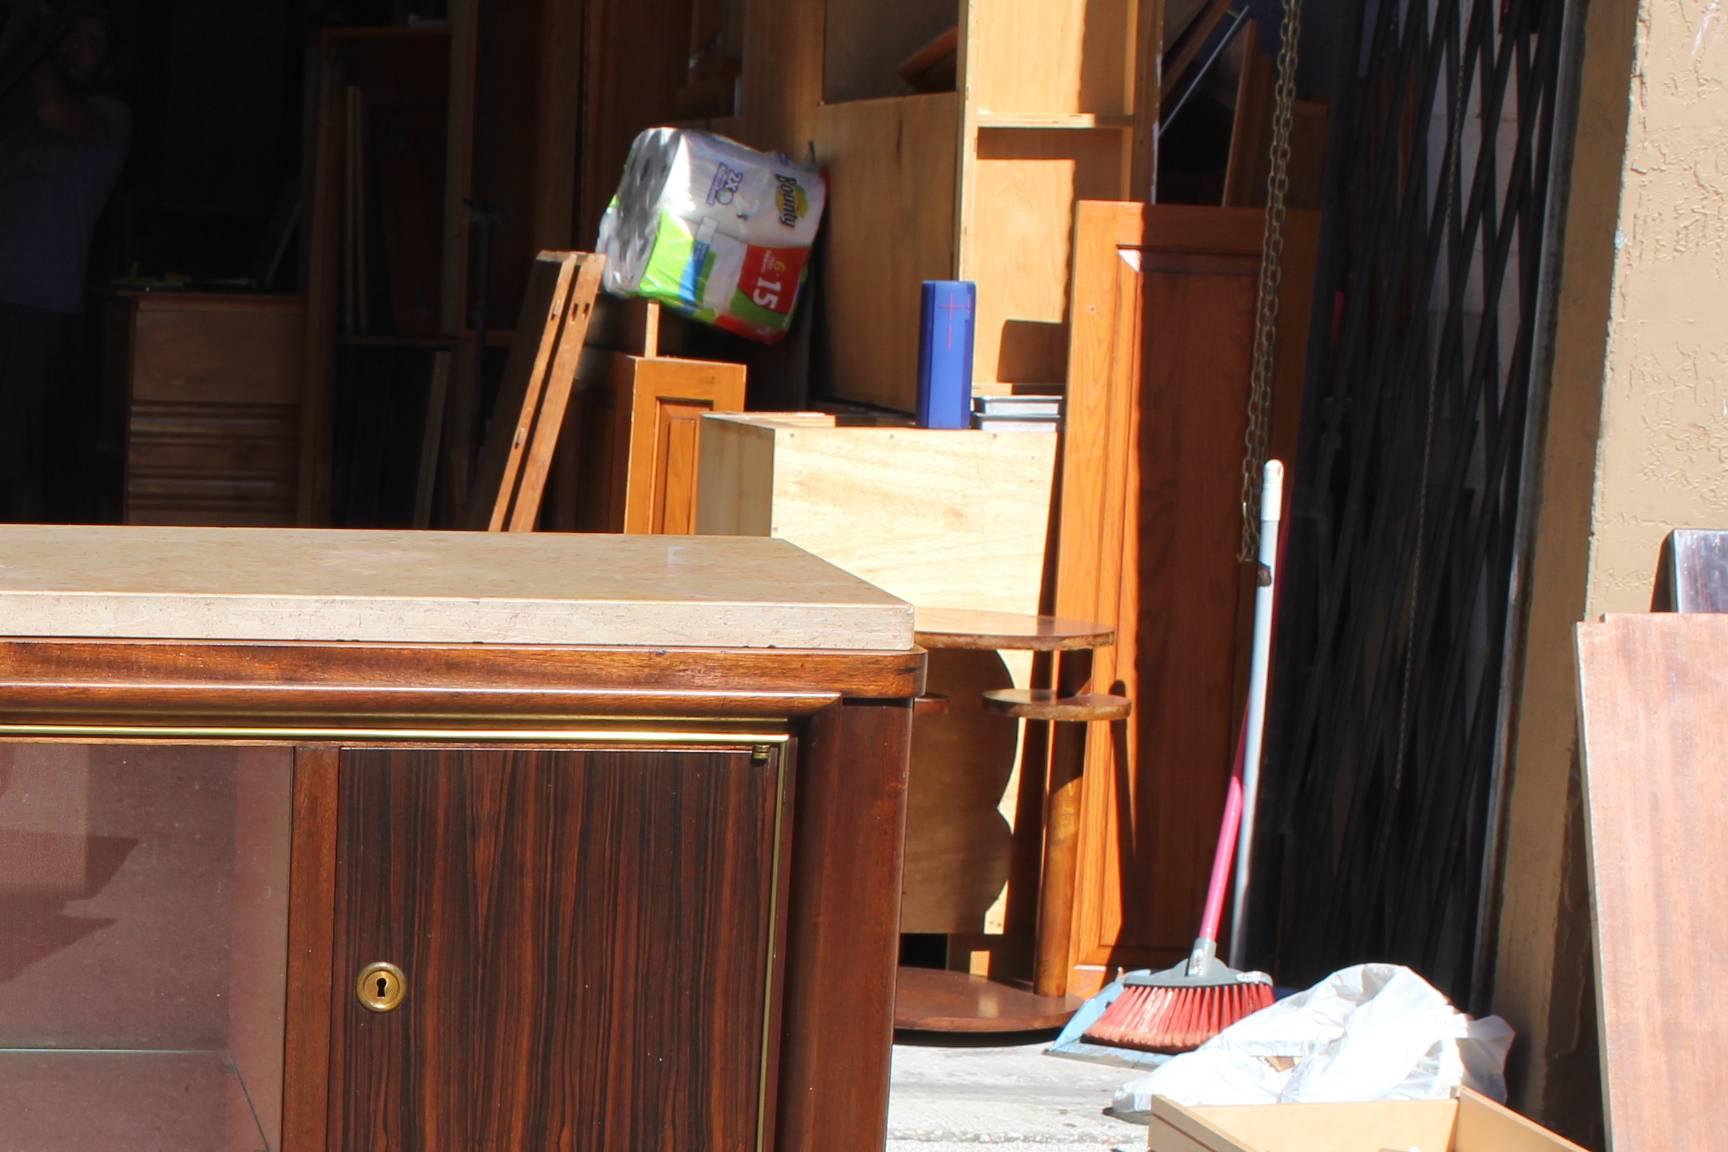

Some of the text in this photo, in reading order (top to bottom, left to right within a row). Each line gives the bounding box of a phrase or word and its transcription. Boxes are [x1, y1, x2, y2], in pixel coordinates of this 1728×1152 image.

[724, 168, 744, 194] 2X
[775, 173, 800, 229] Bounty
[752, 276, 783, 309] 15
